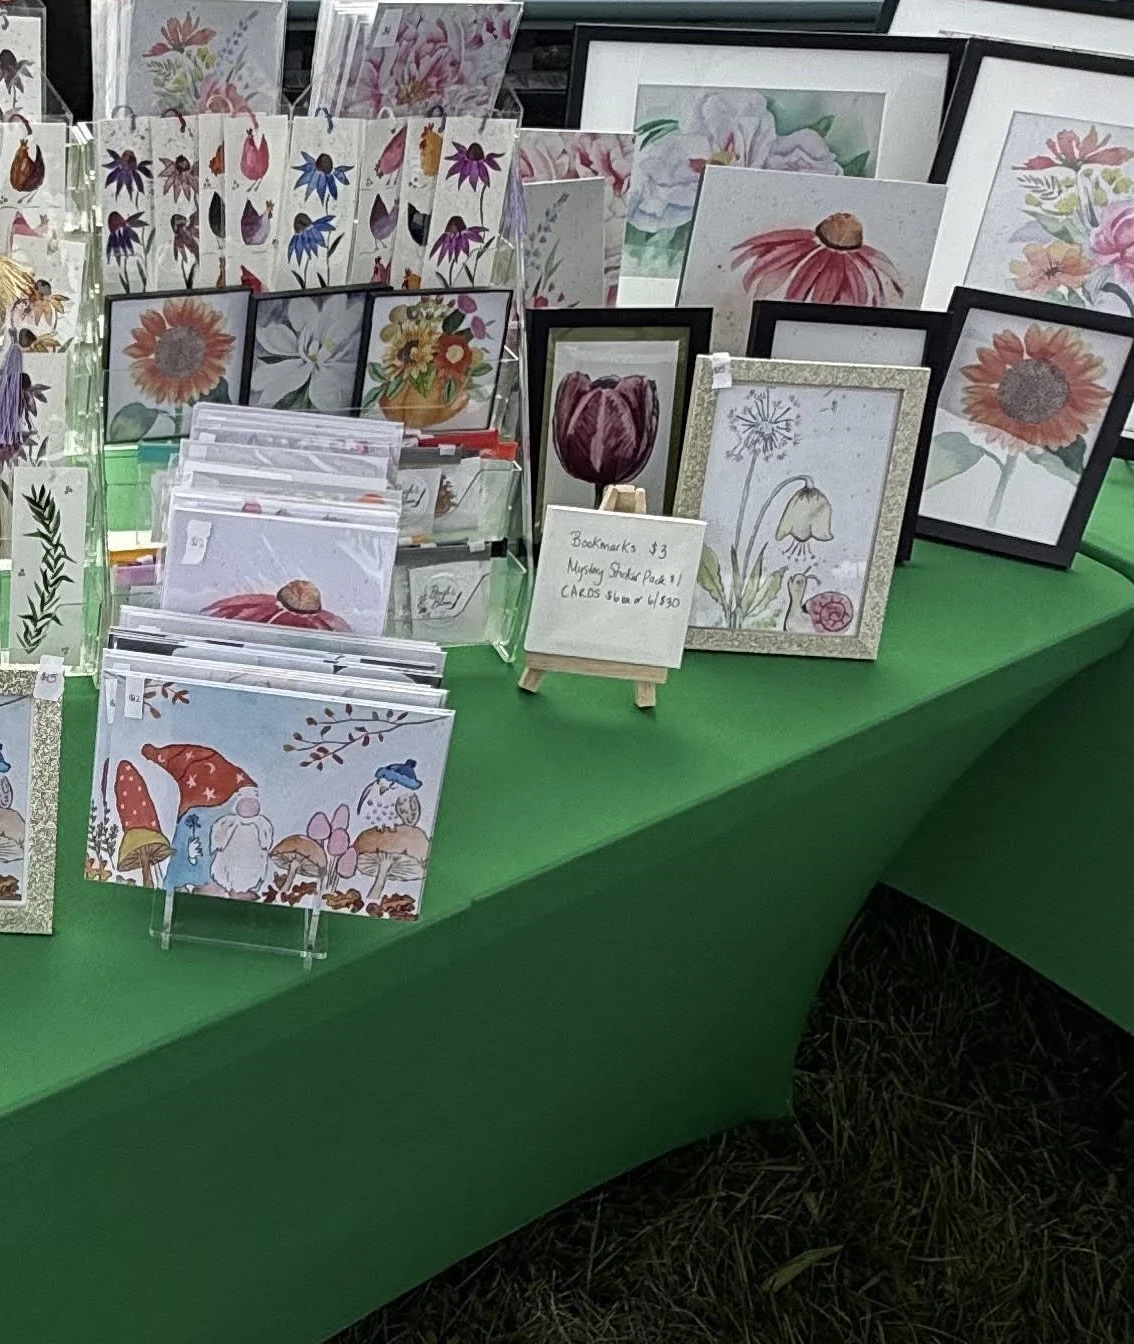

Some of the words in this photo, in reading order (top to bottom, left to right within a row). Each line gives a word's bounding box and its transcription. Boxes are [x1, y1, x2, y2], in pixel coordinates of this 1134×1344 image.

[649, 541, 667, 559] $3
[567, 556, 604, 586] Mystery
[642, 569, 667, 586] Pack
